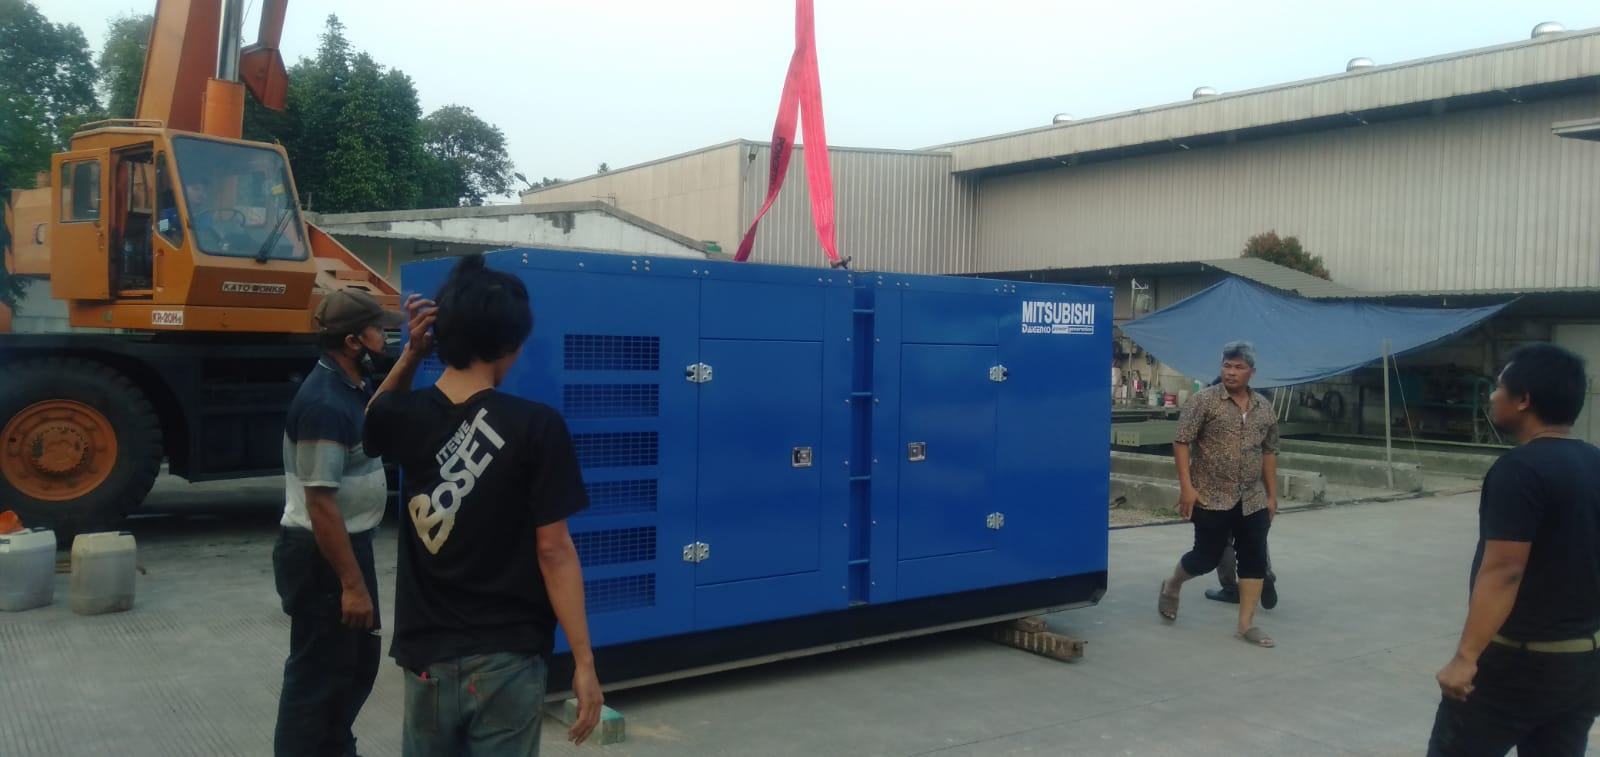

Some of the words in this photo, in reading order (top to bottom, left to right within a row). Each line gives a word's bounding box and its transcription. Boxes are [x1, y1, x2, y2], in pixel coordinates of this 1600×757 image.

[1022, 301, 1094, 324] MITSUBISHI
[436, 420, 470, 464] ITEWE
[408, 408, 505, 554] BOSET
